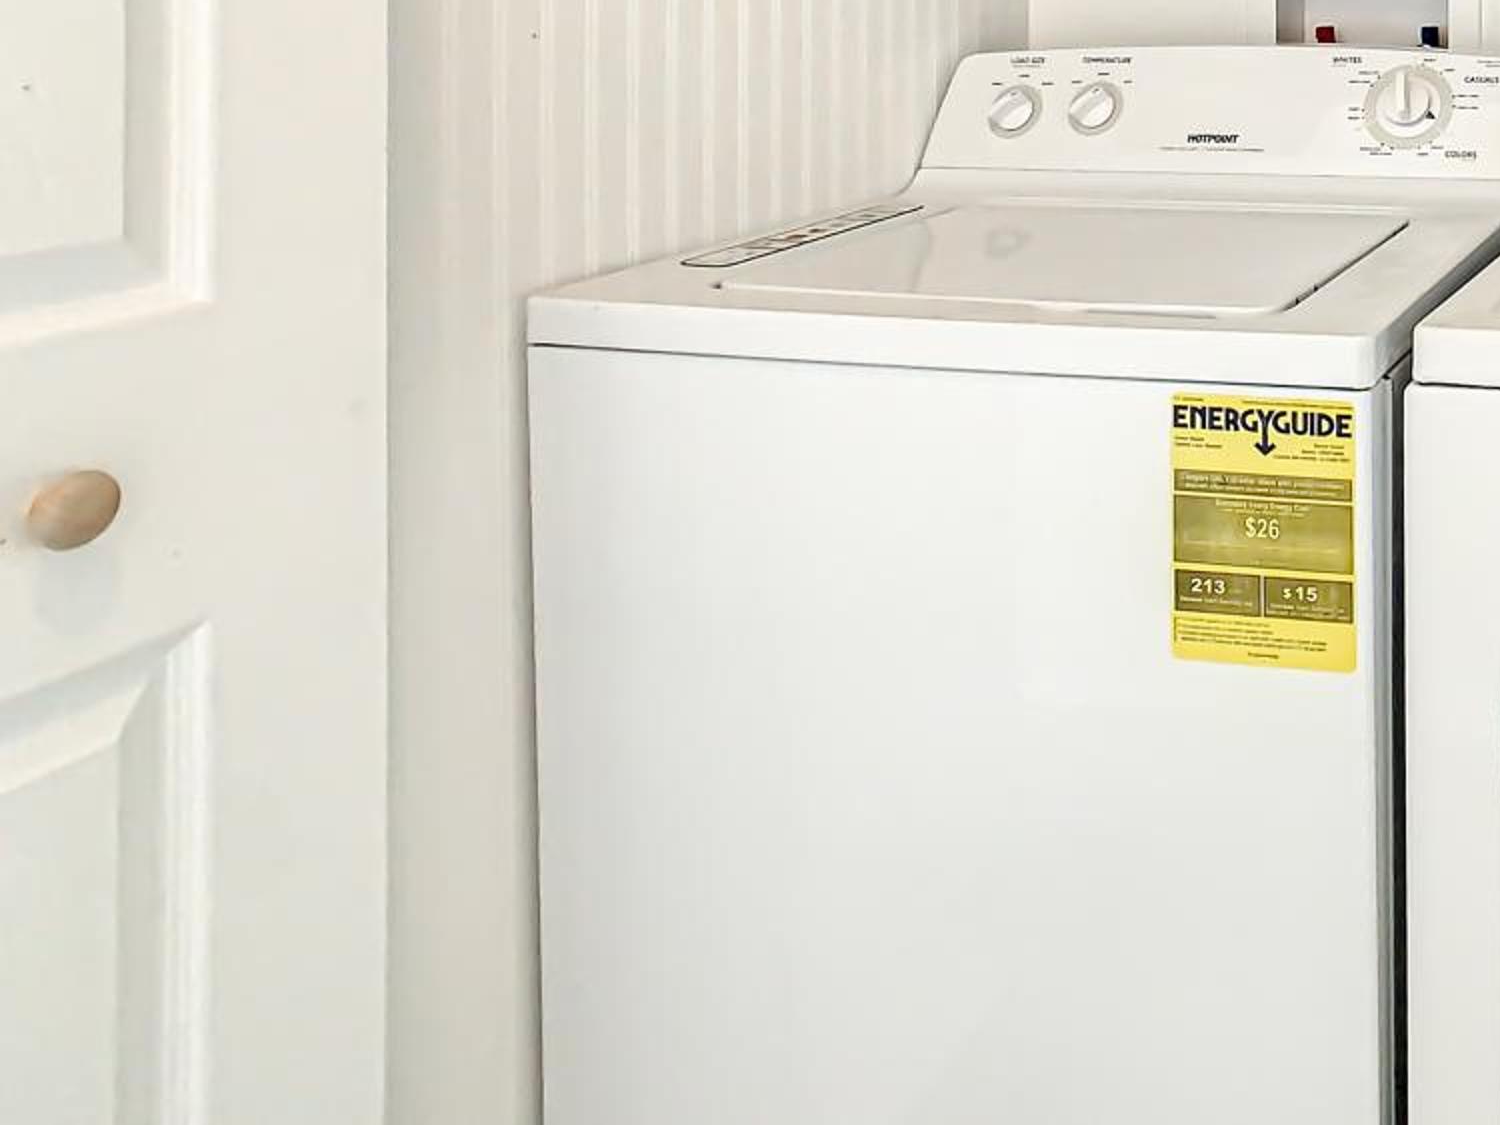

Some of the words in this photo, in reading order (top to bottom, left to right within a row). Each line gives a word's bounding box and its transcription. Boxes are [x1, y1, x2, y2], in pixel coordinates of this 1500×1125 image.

[1332, 56, 1363, 64] WHITES
[1187, 134, 1240, 144] HOTPOINT
[1172, 404, 1353, 439] ENERGYGUIDE
[1244, 516, 1280, 539] $26
[1191, 577, 1226, 595] 213
